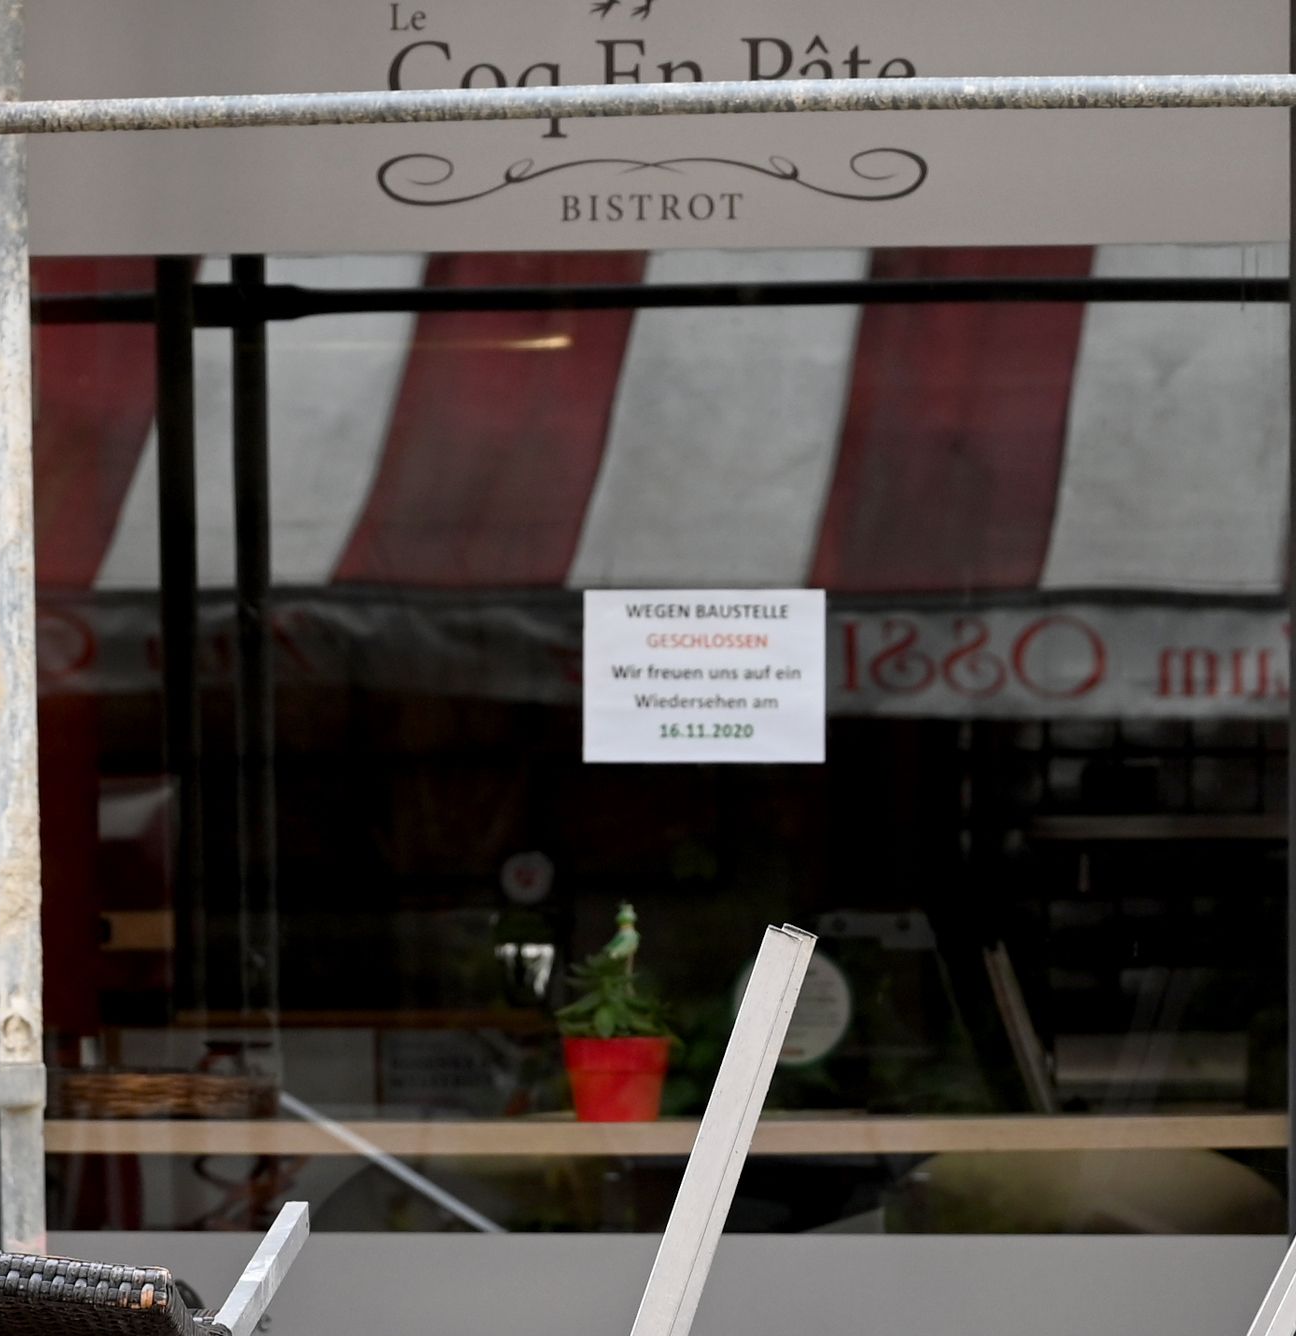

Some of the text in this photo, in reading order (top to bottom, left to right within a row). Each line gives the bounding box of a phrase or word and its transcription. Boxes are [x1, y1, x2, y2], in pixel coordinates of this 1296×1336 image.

[390, 3, 426, 31] Le
[561, 193, 744, 222] BISTROT
[626, 603, 789, 619] WEGEN BAUSTELLE
[647, 633, 769, 649] GESCHLOSSEN
[611, 664, 802, 680] Wir freuen uns auf ein
[634, 693, 779, 709] Wiedersehen am
[660, 723, 754, 739] 16.11.2020
